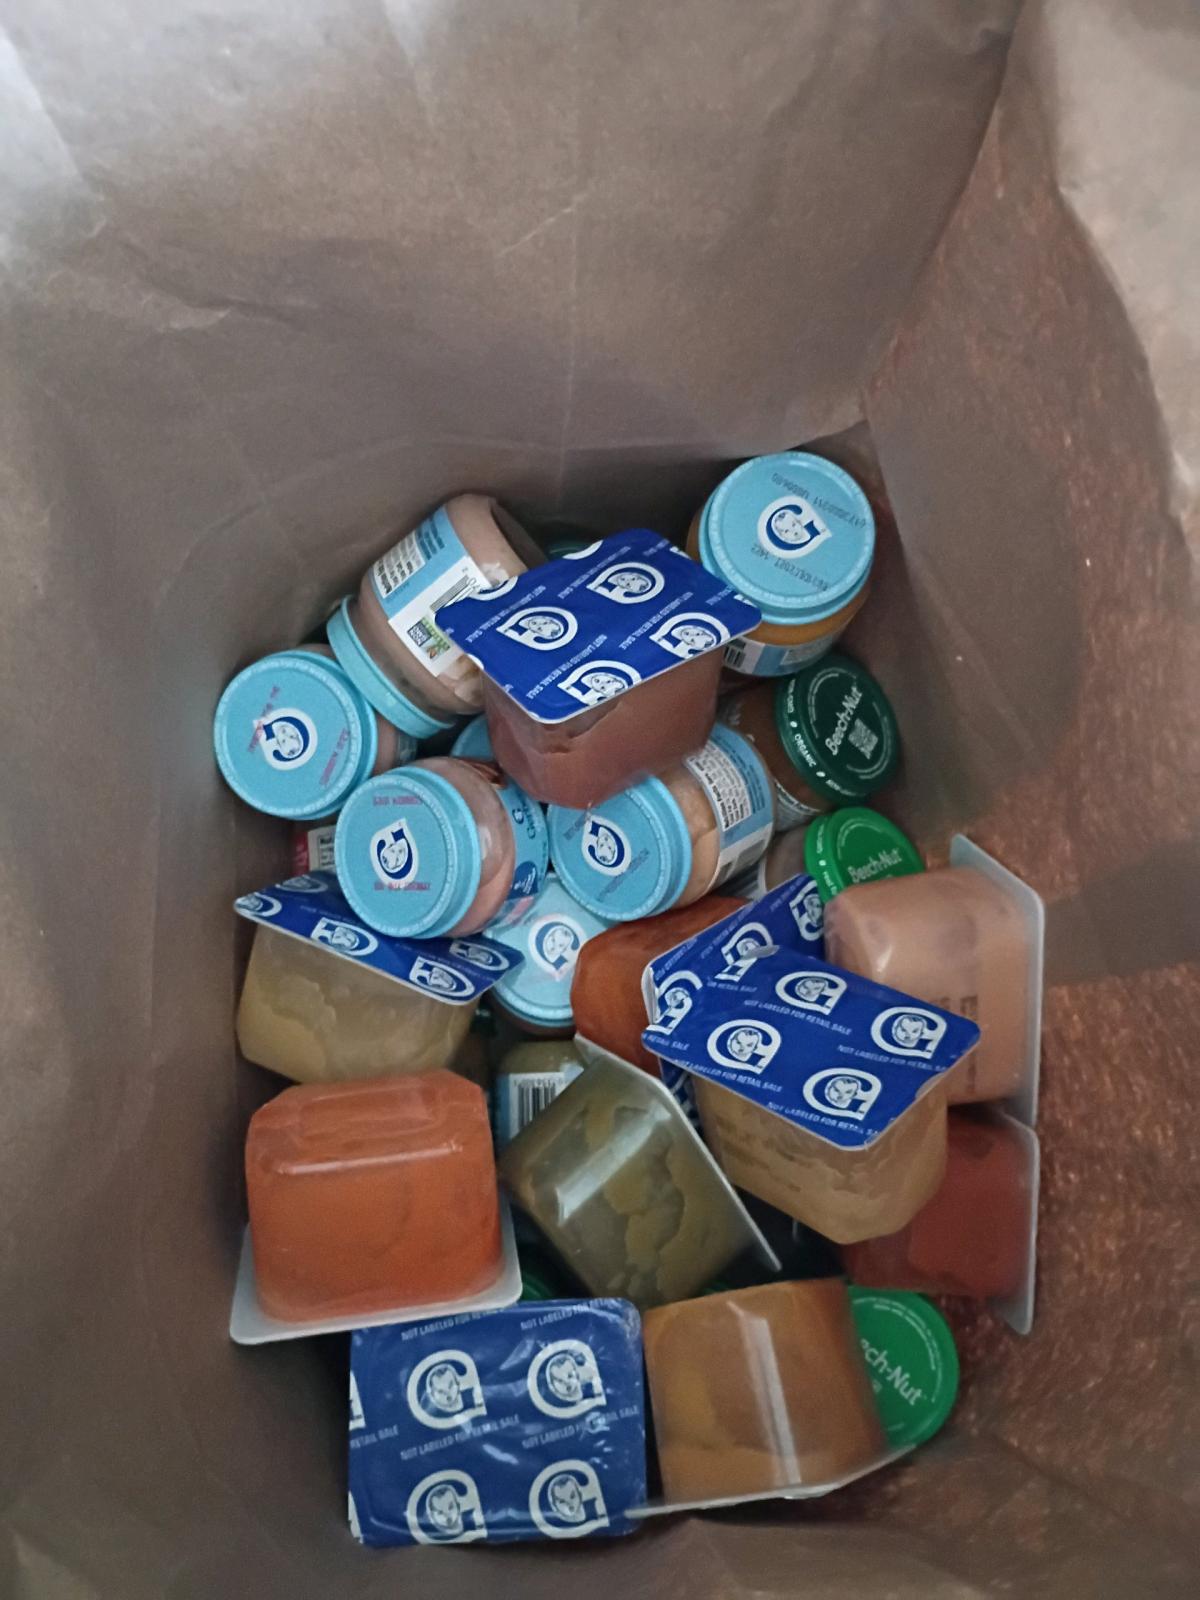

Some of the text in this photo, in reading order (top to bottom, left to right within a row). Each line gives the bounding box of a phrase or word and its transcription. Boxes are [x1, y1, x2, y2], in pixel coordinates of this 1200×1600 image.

[524, 684, 544, 699] SALE
[825, 684, 864, 756] Beech-Nut
[794, 733, 817, 768] ORGANIC
[847, 848, 901, 883] Beech-Nut
[791, 1008, 806, 1020] FOR
[806, 1014, 831, 1029] RETAIL
[831, 1023, 853, 1035] SALE
[672, 1041, 690, 1051] SALE
[837, 1044, 854, 1054] NOT
[854, 1047, 889, 1063] LABELED
[890, 1056, 906, 1065] FOR
[690, 1062, 721, 1076] LABELED
[722, 1071, 737, 1081] FOR
[737, 1074, 762, 1088] RETAIL
[761, 1081, 783, 1092] SALE
[767, 1101, 783, 1110] NOT
[785, 1107, 820, 1122] LABELED
[820, 1115, 837, 1127] FOR
[401, 1327, 419, 1341] NOT
[420, 1318, 454, 1336] LABELED
[520, 1319, 537, 1331] NOT
[539, 1307, 573, 1325] LABELED
[619, 1405, 639, 1418] SALE
[378, 1425, 399, 1440] SALE
[419, 1435, 455, 1455] LABELED
[500, 1414, 520, 1428] SALE
[540, 1425, 575, 1445] LABELED
